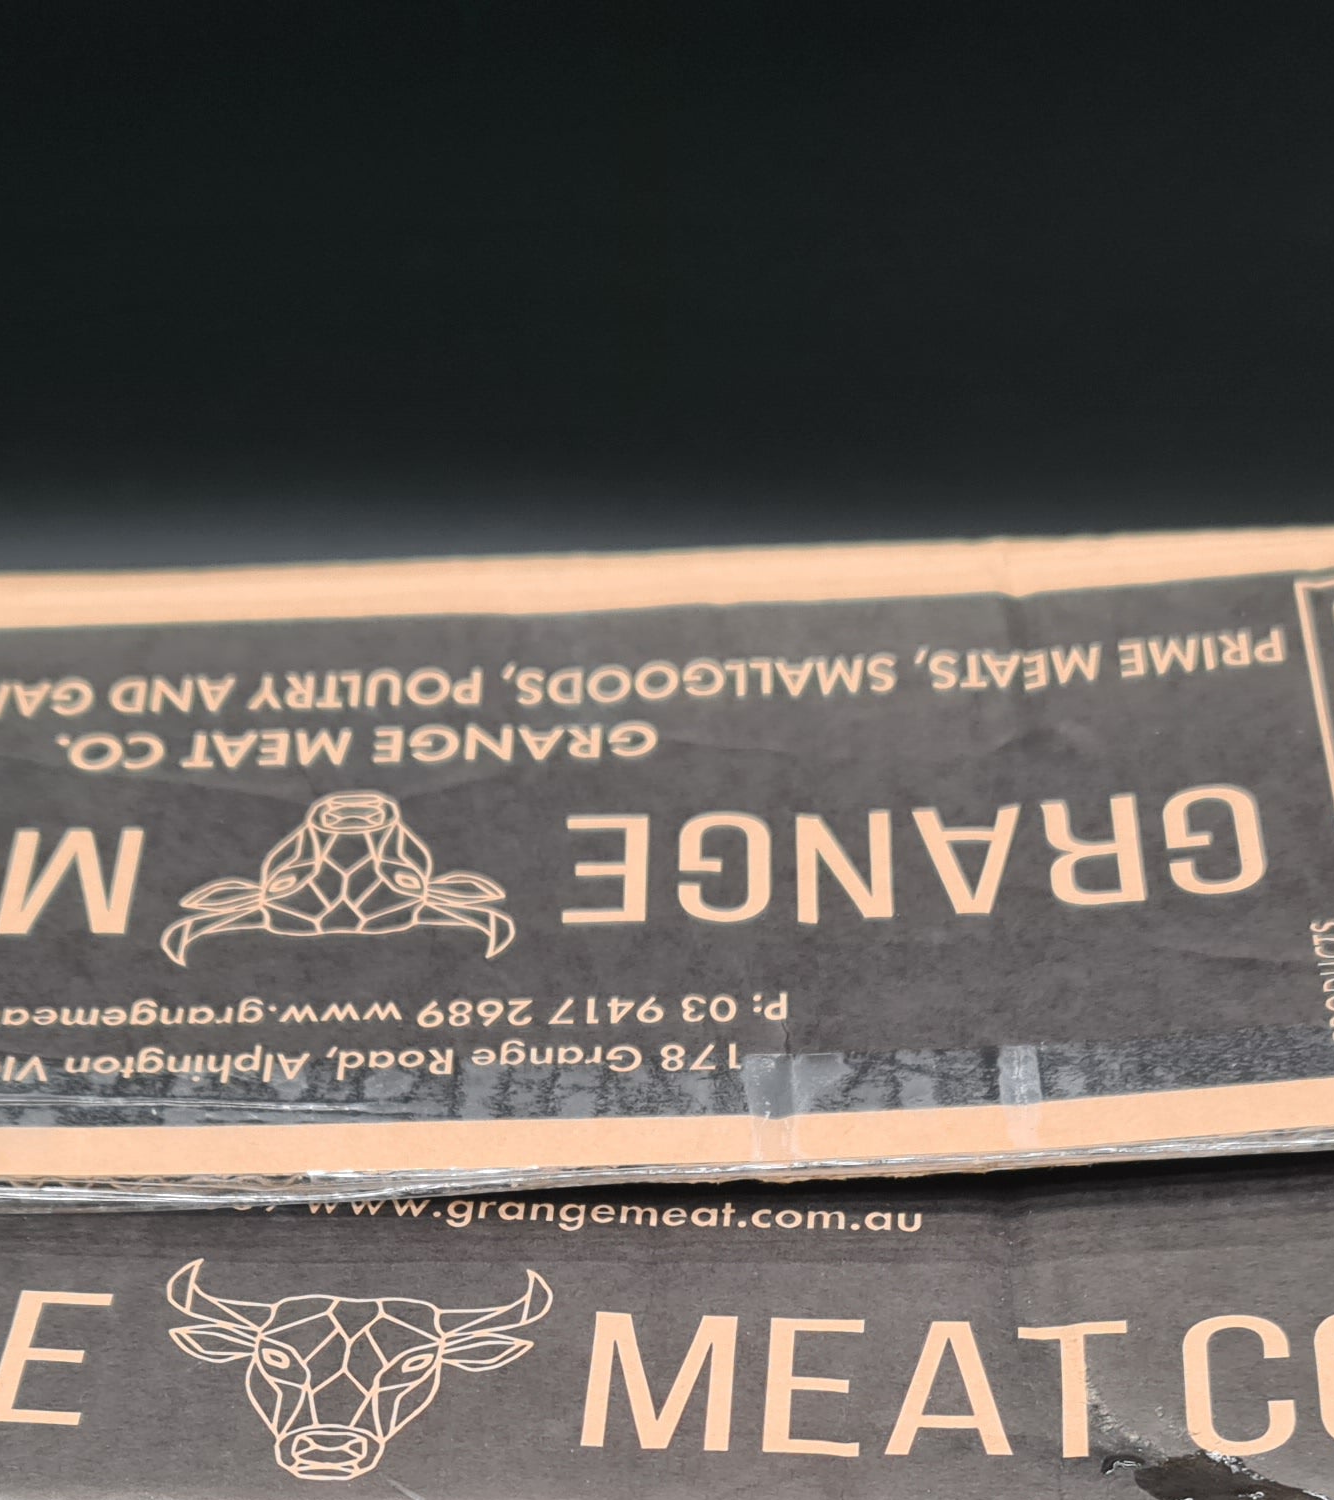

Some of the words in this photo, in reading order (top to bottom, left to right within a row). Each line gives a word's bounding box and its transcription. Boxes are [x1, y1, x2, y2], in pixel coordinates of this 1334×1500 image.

[915, 646, 1101, 692] MEATS,
[1119, 629, 1286, 679] PRIME
[109, 677, 236, 716] AND
[248, 669, 484, 712] POULTRY
[503, 655, 897, 708] SMALLGOODS,
[57, 733, 167, 773] CO.
[182, 729, 353, 771] MEAT
[373, 722, 659, 765] GRANGE
[561, 785, 1267, 927] GRANGE
[414, 997, 535, 1031] 2689
[548, 995, 667, 1027] 9417
[679, 993, 740, 1026] 03
[751, 991, 790, 1024] P:
[63, 1044, 313, 1086] Alphington
[326, 1046, 456, 1083] Road,
[471, 1038, 646, 1075] Grange
[659, 1041, 740, 1073] 178
[580, 1310, 1129, 1461] MEAT
